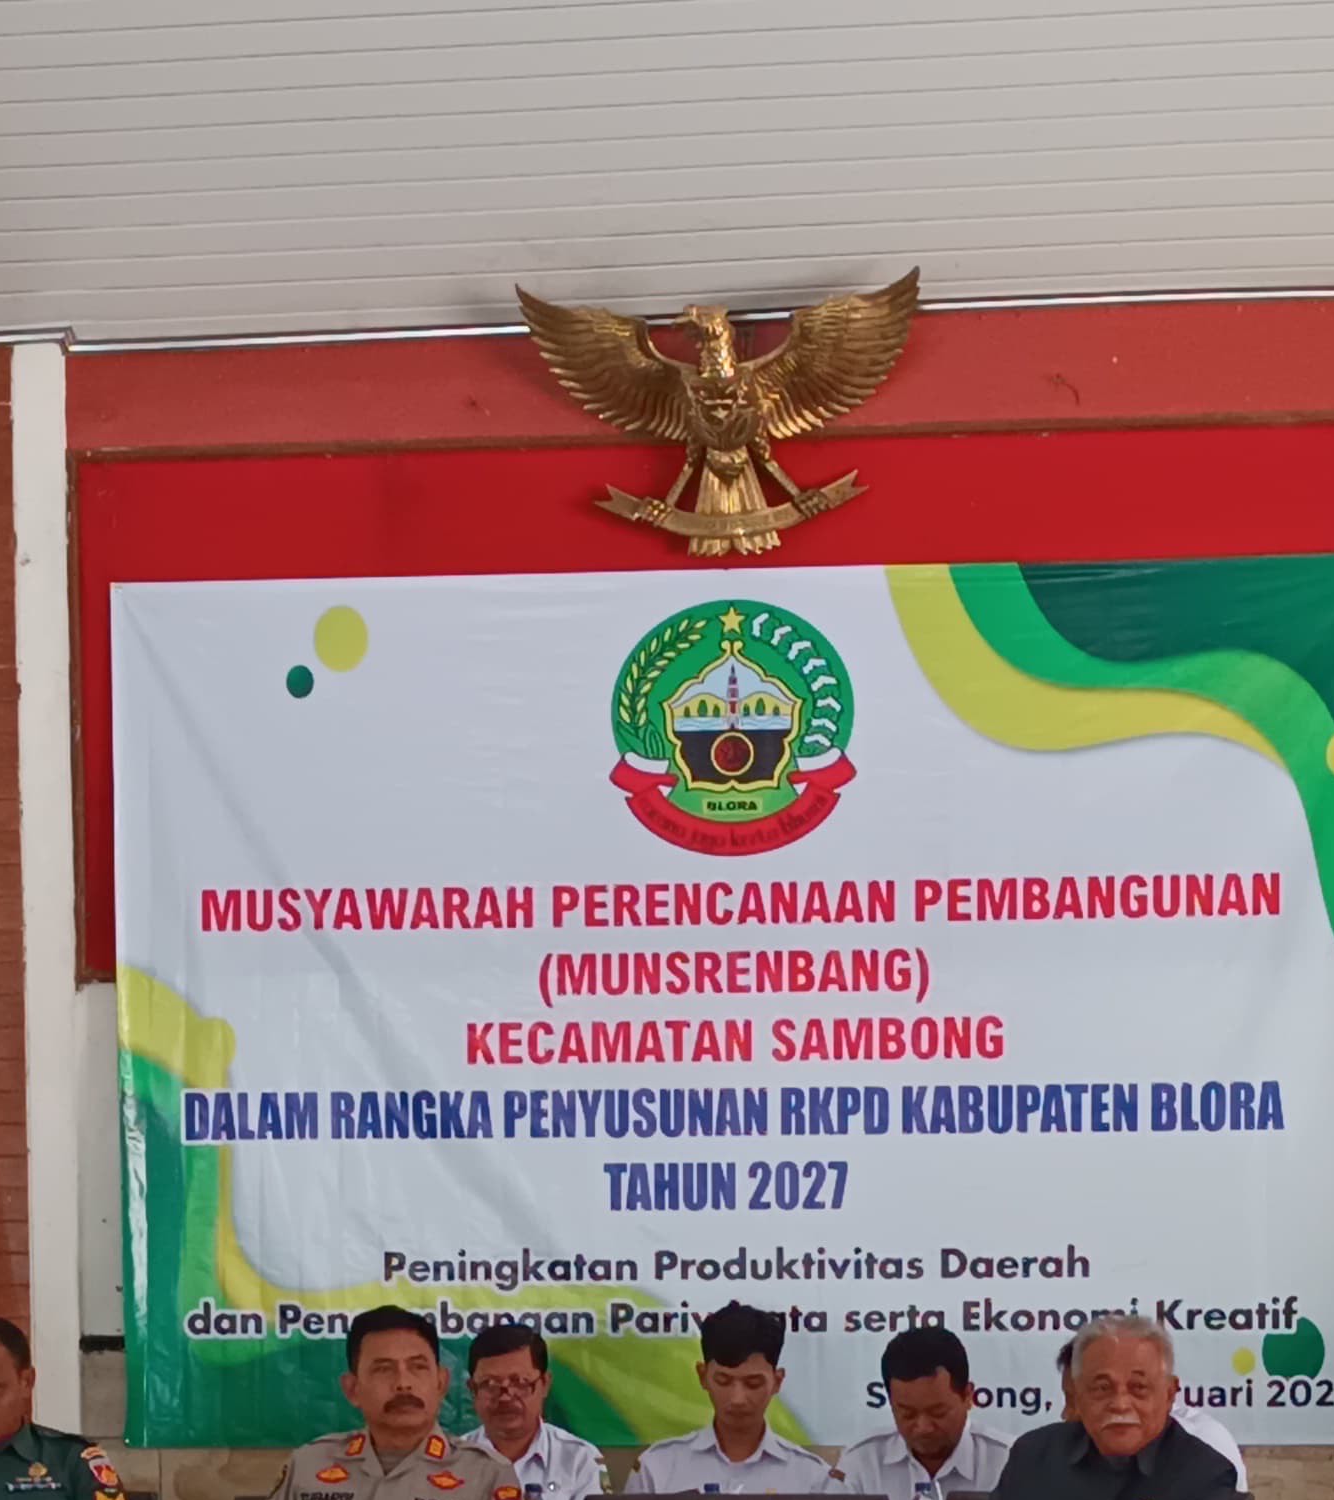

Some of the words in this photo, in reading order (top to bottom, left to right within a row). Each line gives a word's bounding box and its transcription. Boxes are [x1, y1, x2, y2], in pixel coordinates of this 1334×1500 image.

[707, 801, 758, 811] BLORA
[200, 886, 535, 933] MUSYAWARAH
[551, 879, 897, 928] PERENCANAAN
[914, 871, 1282, 922] PEMBANGUNAN
[538, 947, 930, 1009] (MUNSRENBANG)
[467, 1018, 754, 1065] KECAMATAN
[770, 1015, 1005, 1062] SAMBONG
[183, 1091, 319, 1141] DALAM
[330, 1090, 494, 1140] RANGKA
[503, 1087, 768, 1139] PENYUSUNAN
[780, 1086, 890, 1136] RKPD
[901, 1083, 1139, 1135] KABUPATEN
[1150, 1080, 1286, 1132] BLORA
[603, 1162, 737, 1212] TAHUN
[747, 1161, 849, 1211] 2027
[383, 1249, 639, 1290] Peningkatan
[653, 1246, 925, 1281] Produktivitas
[939, 1244, 1091, 1279] Daerah
[187, 1302, 264, 1336] dan
[844, 1303, 945, 1332] serta
[1156, 1295, 1299, 1330] Kreatif
[867, 1380, 1053, 1416] Song,
